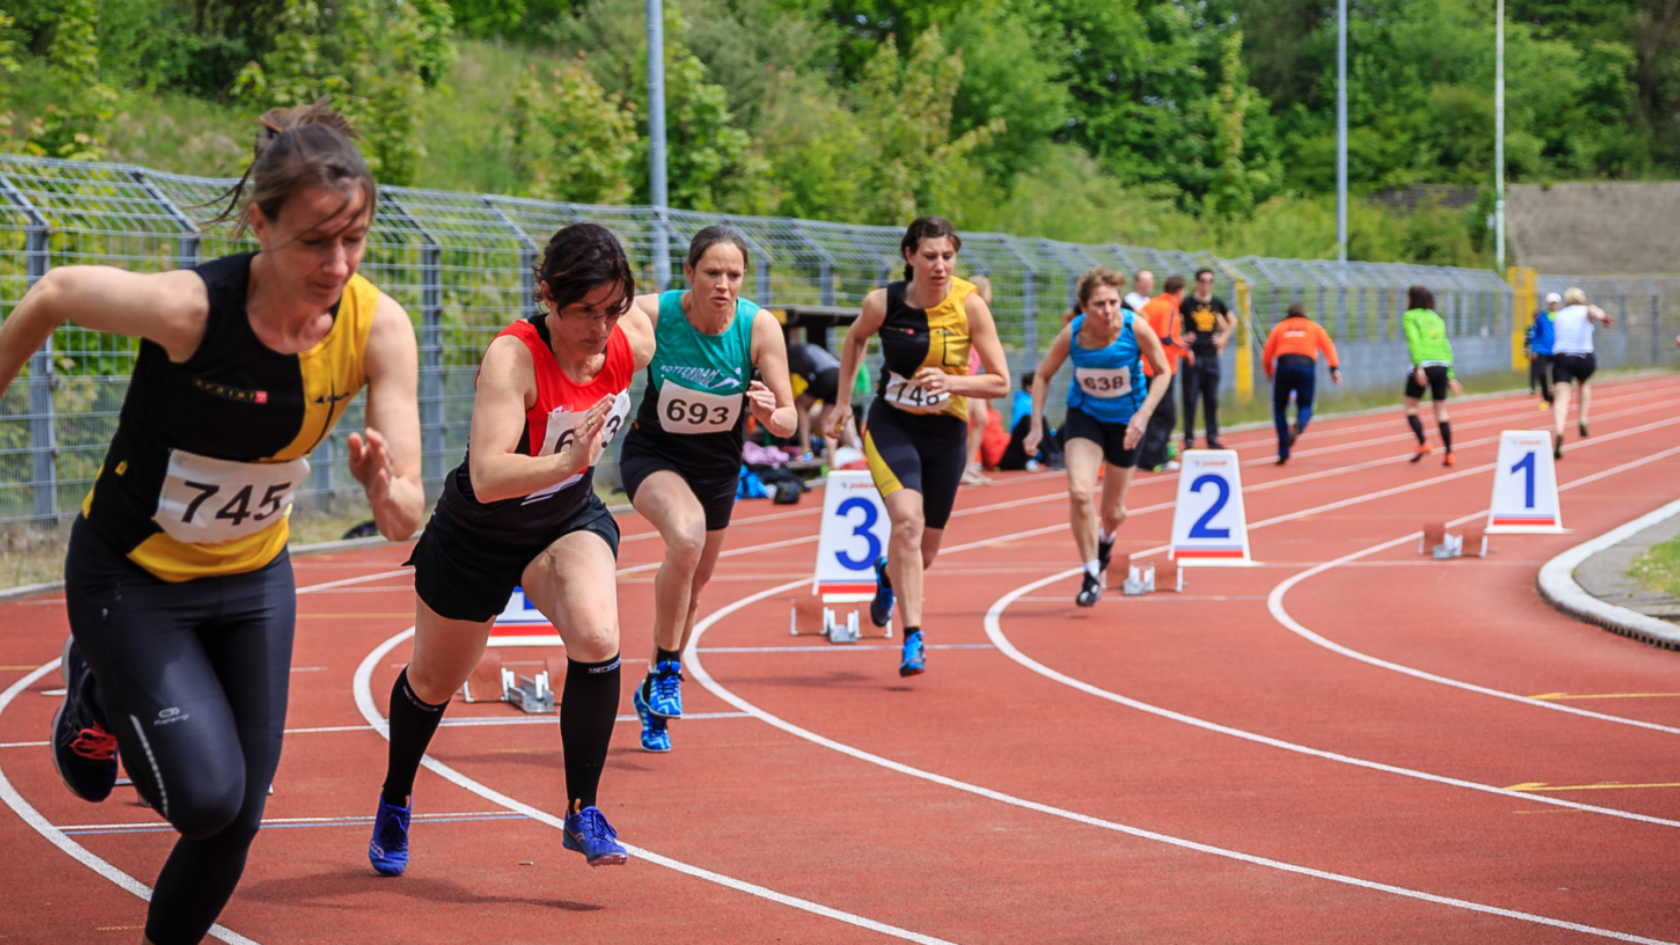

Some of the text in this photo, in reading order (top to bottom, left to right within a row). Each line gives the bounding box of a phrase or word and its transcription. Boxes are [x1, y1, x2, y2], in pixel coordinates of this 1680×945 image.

[1083, 376, 1124, 391] 638
[666, 398, 730, 425] 693
[181, 480, 291, 526] 745
[1511, 452, 1535, 508] 1
[1188, 474, 1230, 538] 2
[835, 496, 881, 571] 3
